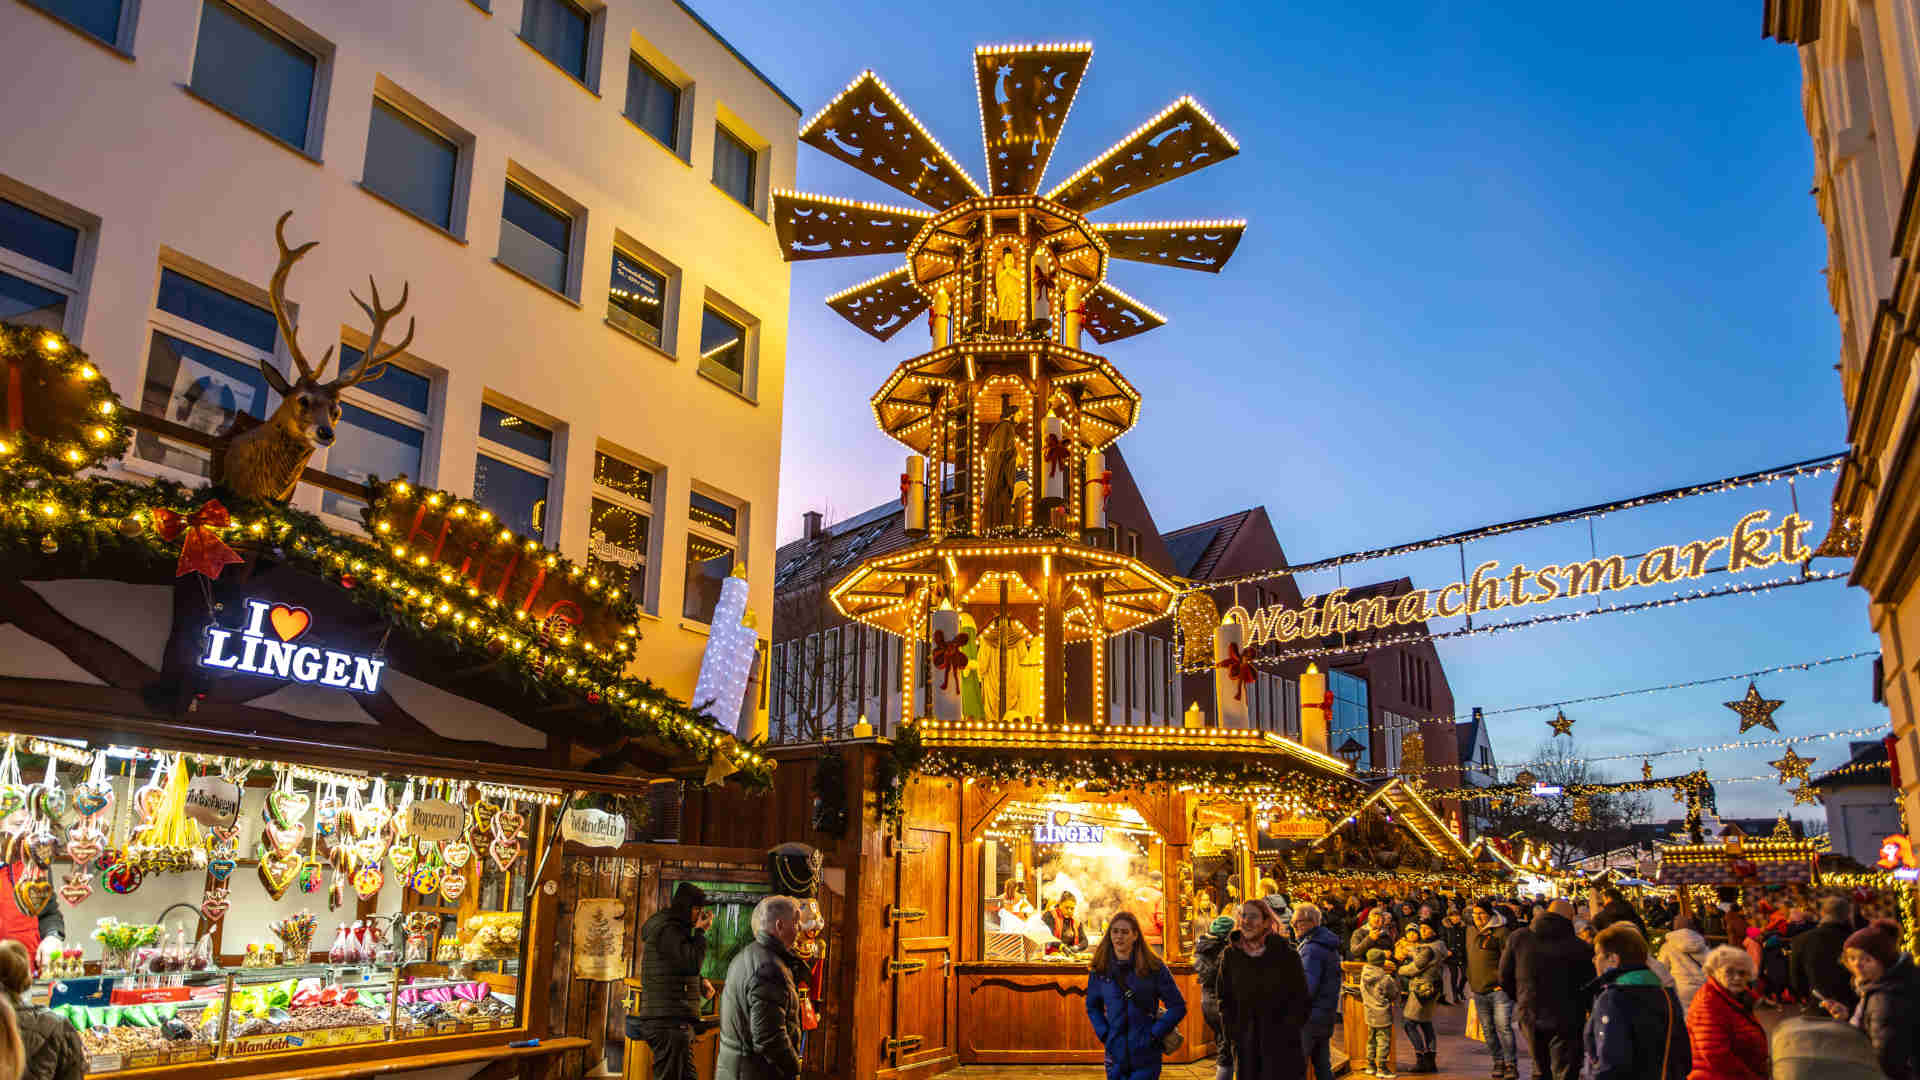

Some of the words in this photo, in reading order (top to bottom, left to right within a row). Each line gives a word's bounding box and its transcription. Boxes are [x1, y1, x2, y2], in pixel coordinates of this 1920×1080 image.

[1227, 509, 1813, 648] Weihnachtsmarkt
[244, 601, 270, 639] I
[203, 629, 385, 693] LINGEN
[413, 807, 456, 831] Popcorn
[571, 815, 617, 837] Mandeln
[1034, 825, 1105, 843] LINGEN
[235, 1038, 289, 1054] Mandeln
